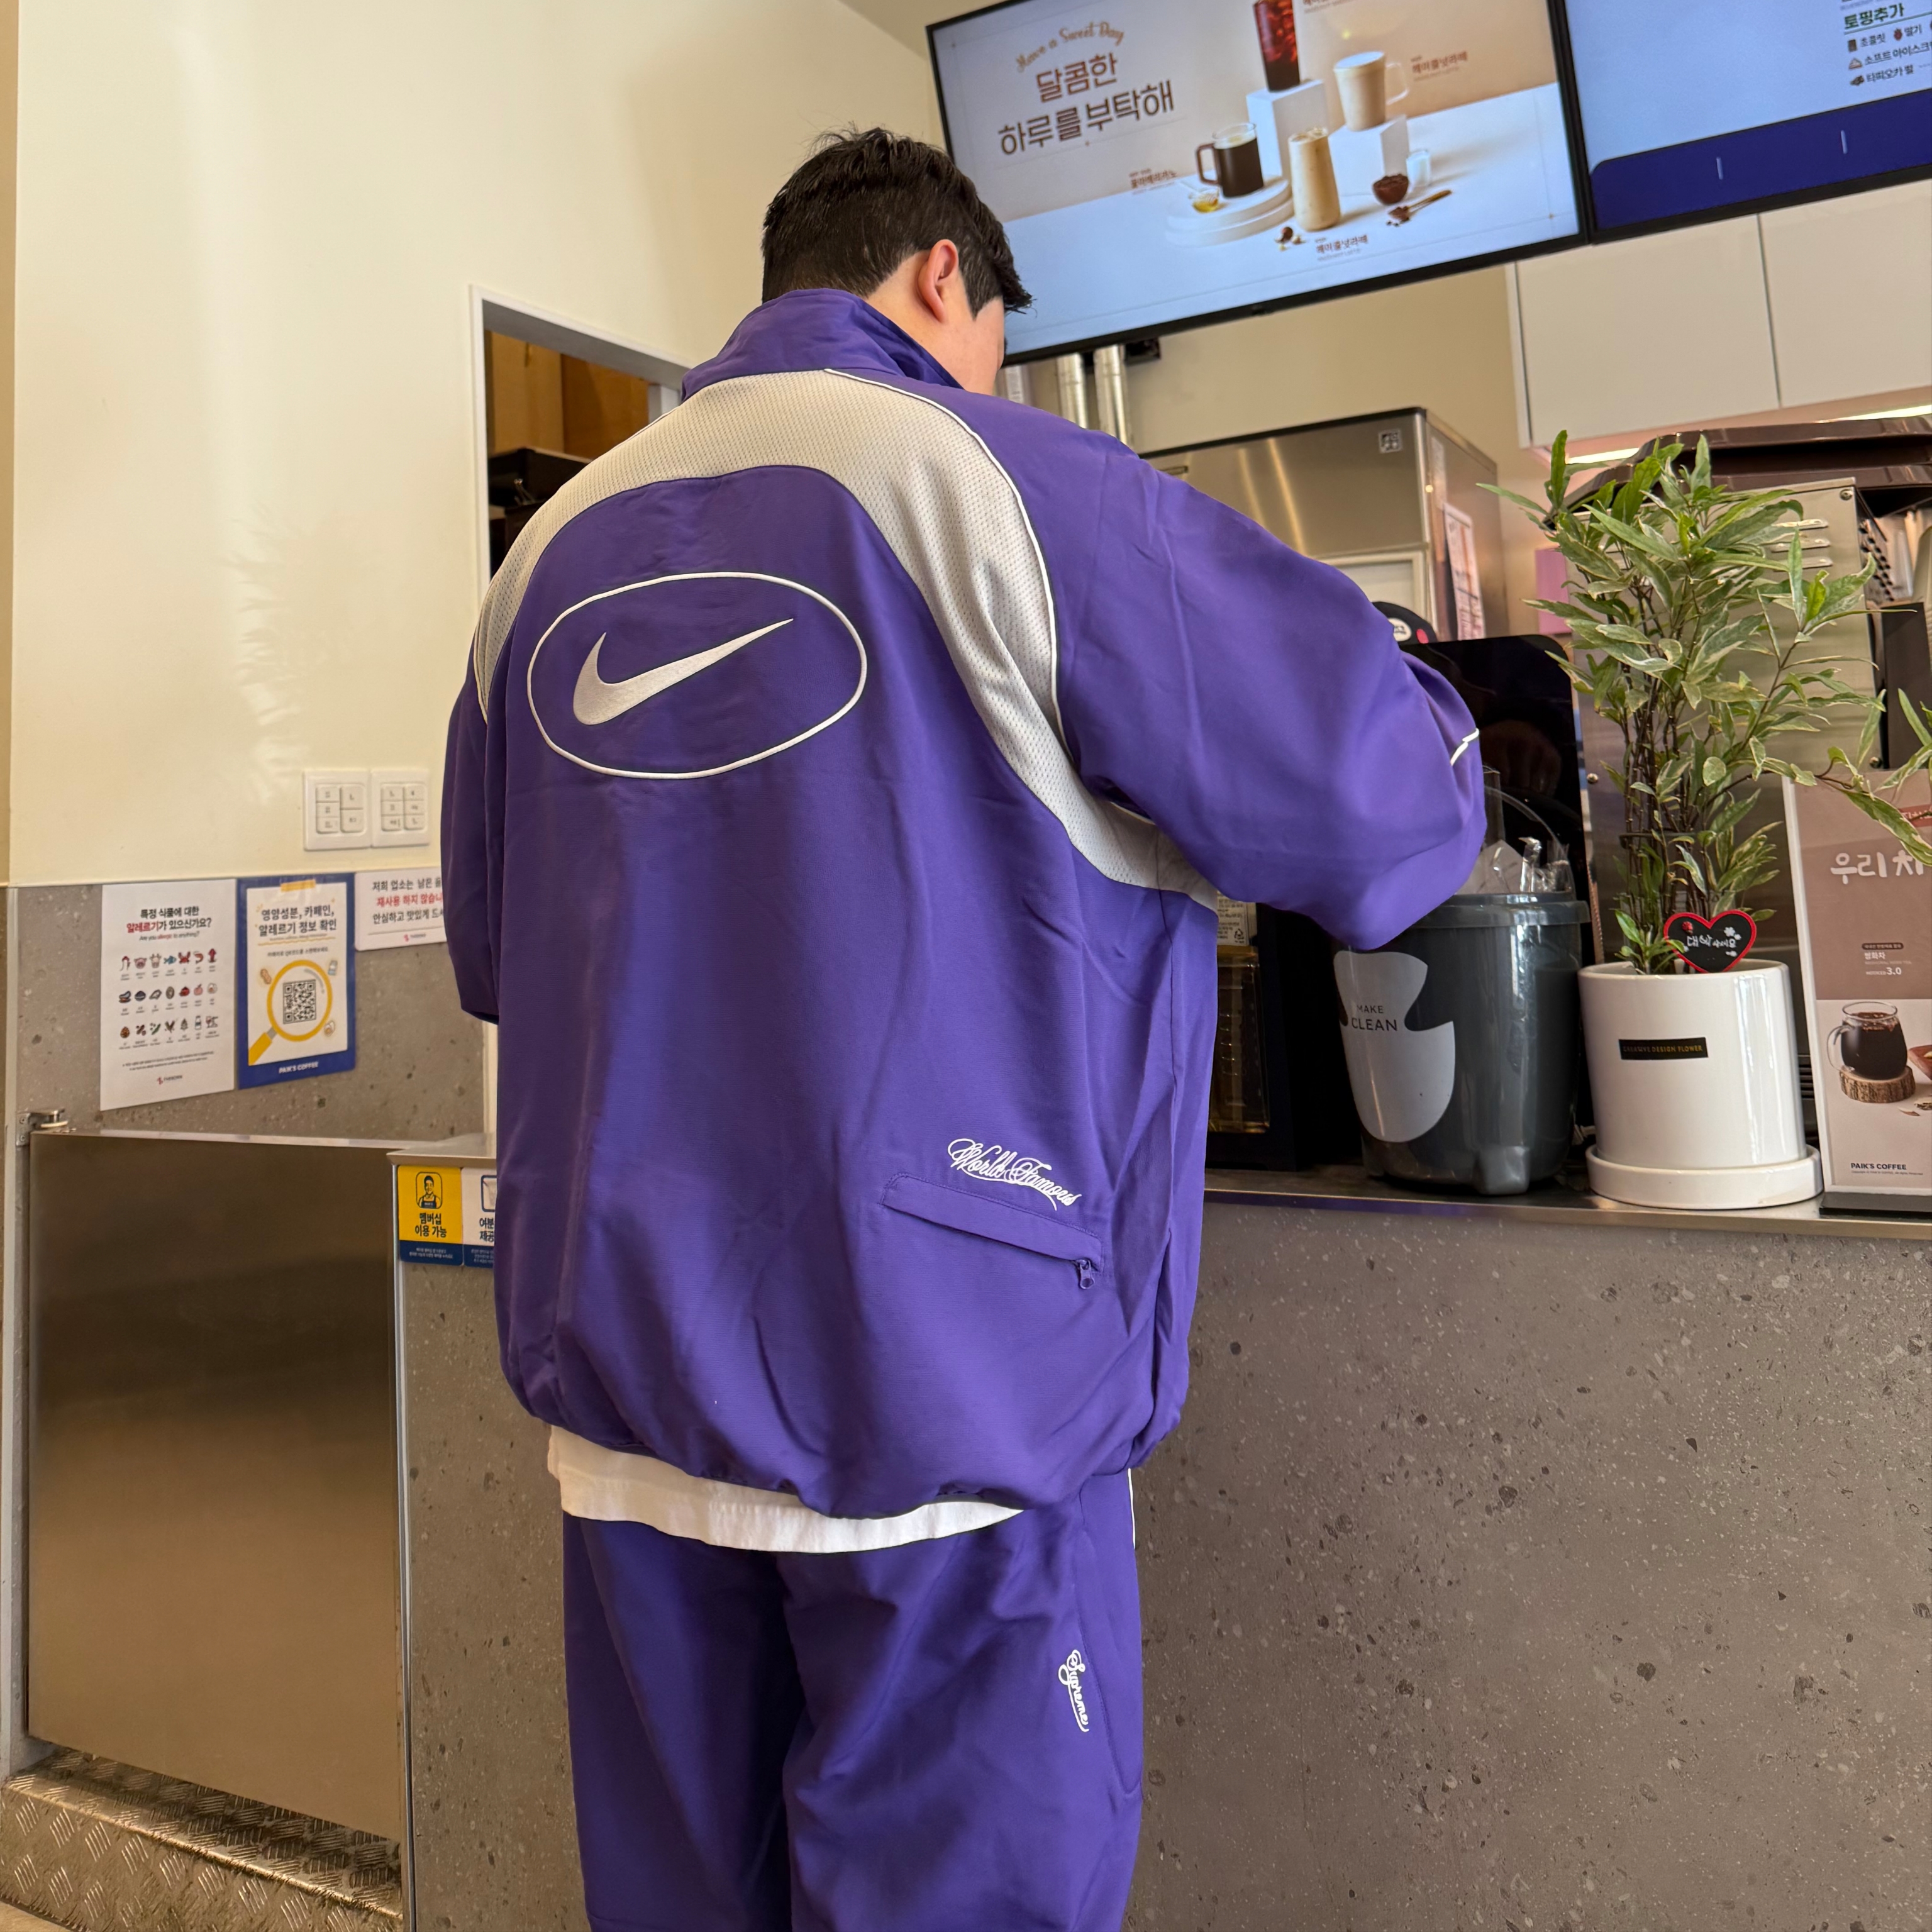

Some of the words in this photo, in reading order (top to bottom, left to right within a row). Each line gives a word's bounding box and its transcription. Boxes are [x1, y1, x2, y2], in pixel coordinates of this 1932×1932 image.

[1845, 3, 1904, 30] 토핑추가
[1059, 22, 1094, 42] Sweet
[1099, 21, 1124, 47] Day
[1036, 52, 1118, 103] 달콤한
[997, 107, 1082, 156] 하루를
[1086, 79, 1174, 131] 부탁해
[372, 880, 388, 892] 저희
[391, 879, 413, 891] 업소는
[377, 895, 400, 908] 재사용
[403, 894, 418, 906] 하지
[420, 892, 443, 905] 않습니
[140, 909, 157, 919] 특정
[158, 907, 182, 918] 식품에
[184, 906, 199, 916] 대한
[261, 908, 302, 921] 영양성분,
[304, 904, 335, 918] 카페인,
[372, 911, 404, 924] 안심하고
[406, 909, 430, 921] 맛있게
[126, 921, 167, 933] 알레르기가
[169, 918, 212, 930] 있으신가요?
[258, 921, 296, 937] 알레르기
[299, 921, 317, 934] 정보
[319, 918, 337, 931] 확인
[1886, 967, 1902, 975] 3.0
[1357, 1005, 1384, 1014] MAKE
[1352, 1017, 1397, 1031] CLEAN
[948, 1138, 1018, 1182] World
[1004, 1157, 1082, 1206] Famous
[419, 1213, 442, 1225] 멤버십
[414, 1226, 430, 1238] 이용
[432, 1226, 447, 1238] 가능
[1058, 1649, 1090, 1733] Supreme
